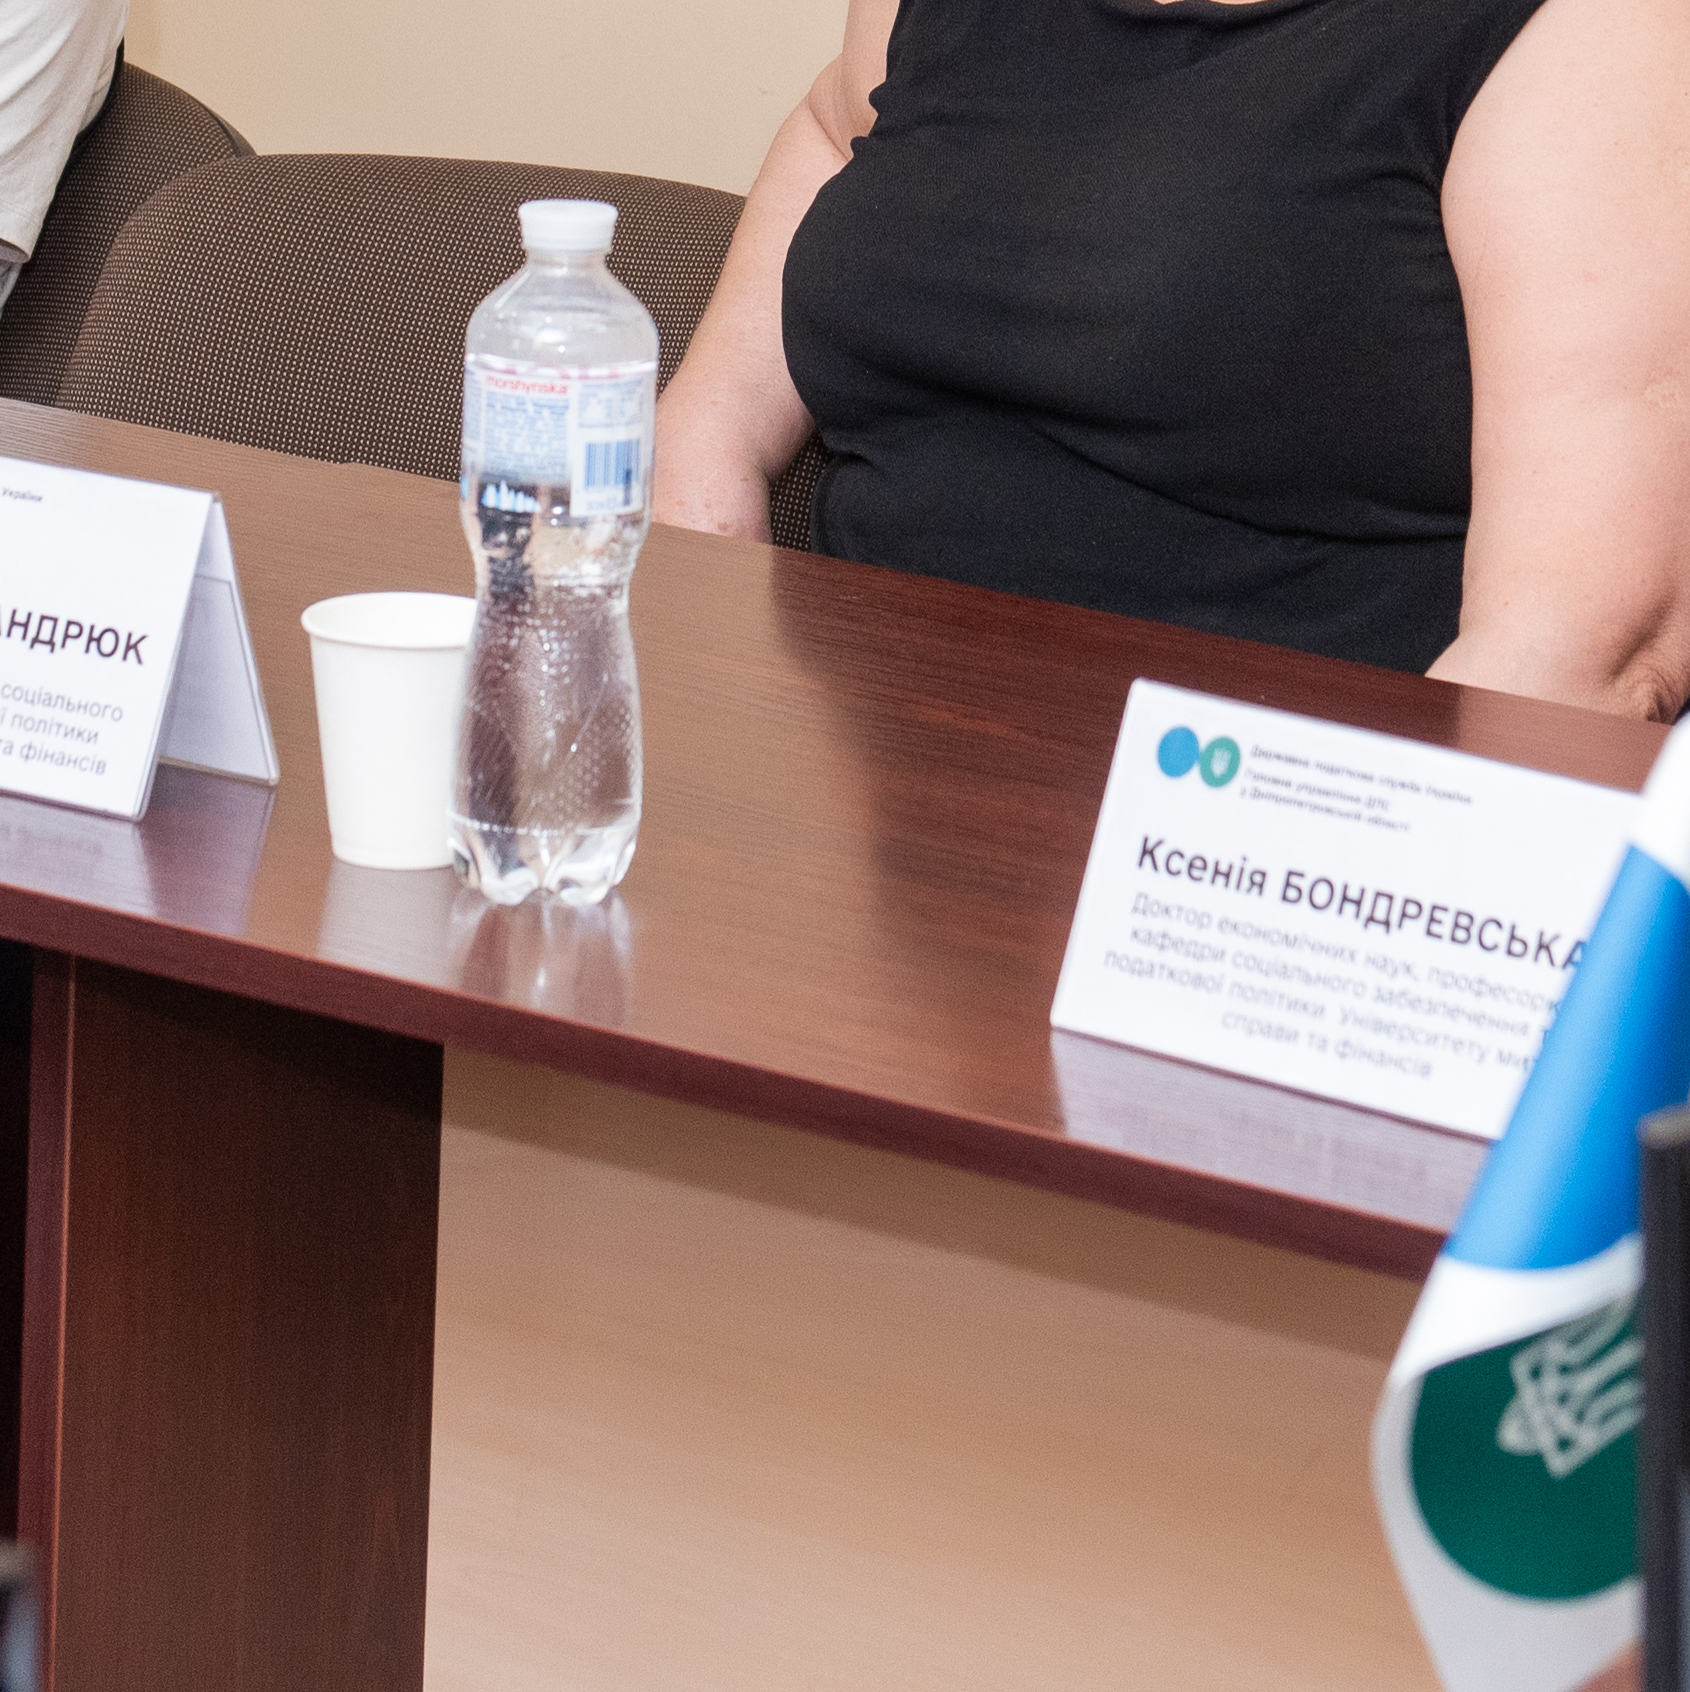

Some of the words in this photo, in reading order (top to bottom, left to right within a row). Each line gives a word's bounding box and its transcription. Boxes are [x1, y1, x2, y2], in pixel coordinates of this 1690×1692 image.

[2, 486, 43, 503] України
[0, 682, 123, 722] соціального
[10, 712, 99, 746] політики
[19, 740, 108, 776] фінансів
[1138, 835, 1267, 897] Ксенія
[1282, 870, 1586, 970] БОНДРЕВСЬКА
[1130, 891, 1213, 930] Доктор
[1217, 915, 1357, 963] економічних
[1364, 951, 1419, 982] наук,
[1428, 966, 1559, 1011] професорк
[1130, 927, 1226, 963] кафедри
[1231, 949, 1366, 1000] соціального
[1373, 985, 1529, 1037] забезпечення
[1103, 949, 1225, 994] податкової
[1228, 980, 1326, 1019] політики
[1339, 1005, 1492, 1064] Університету
[1220, 1010, 1300, 1046] справи
[1307, 1030, 1329, 1054] та
[1334, 1036, 1434, 1079] фінансів
